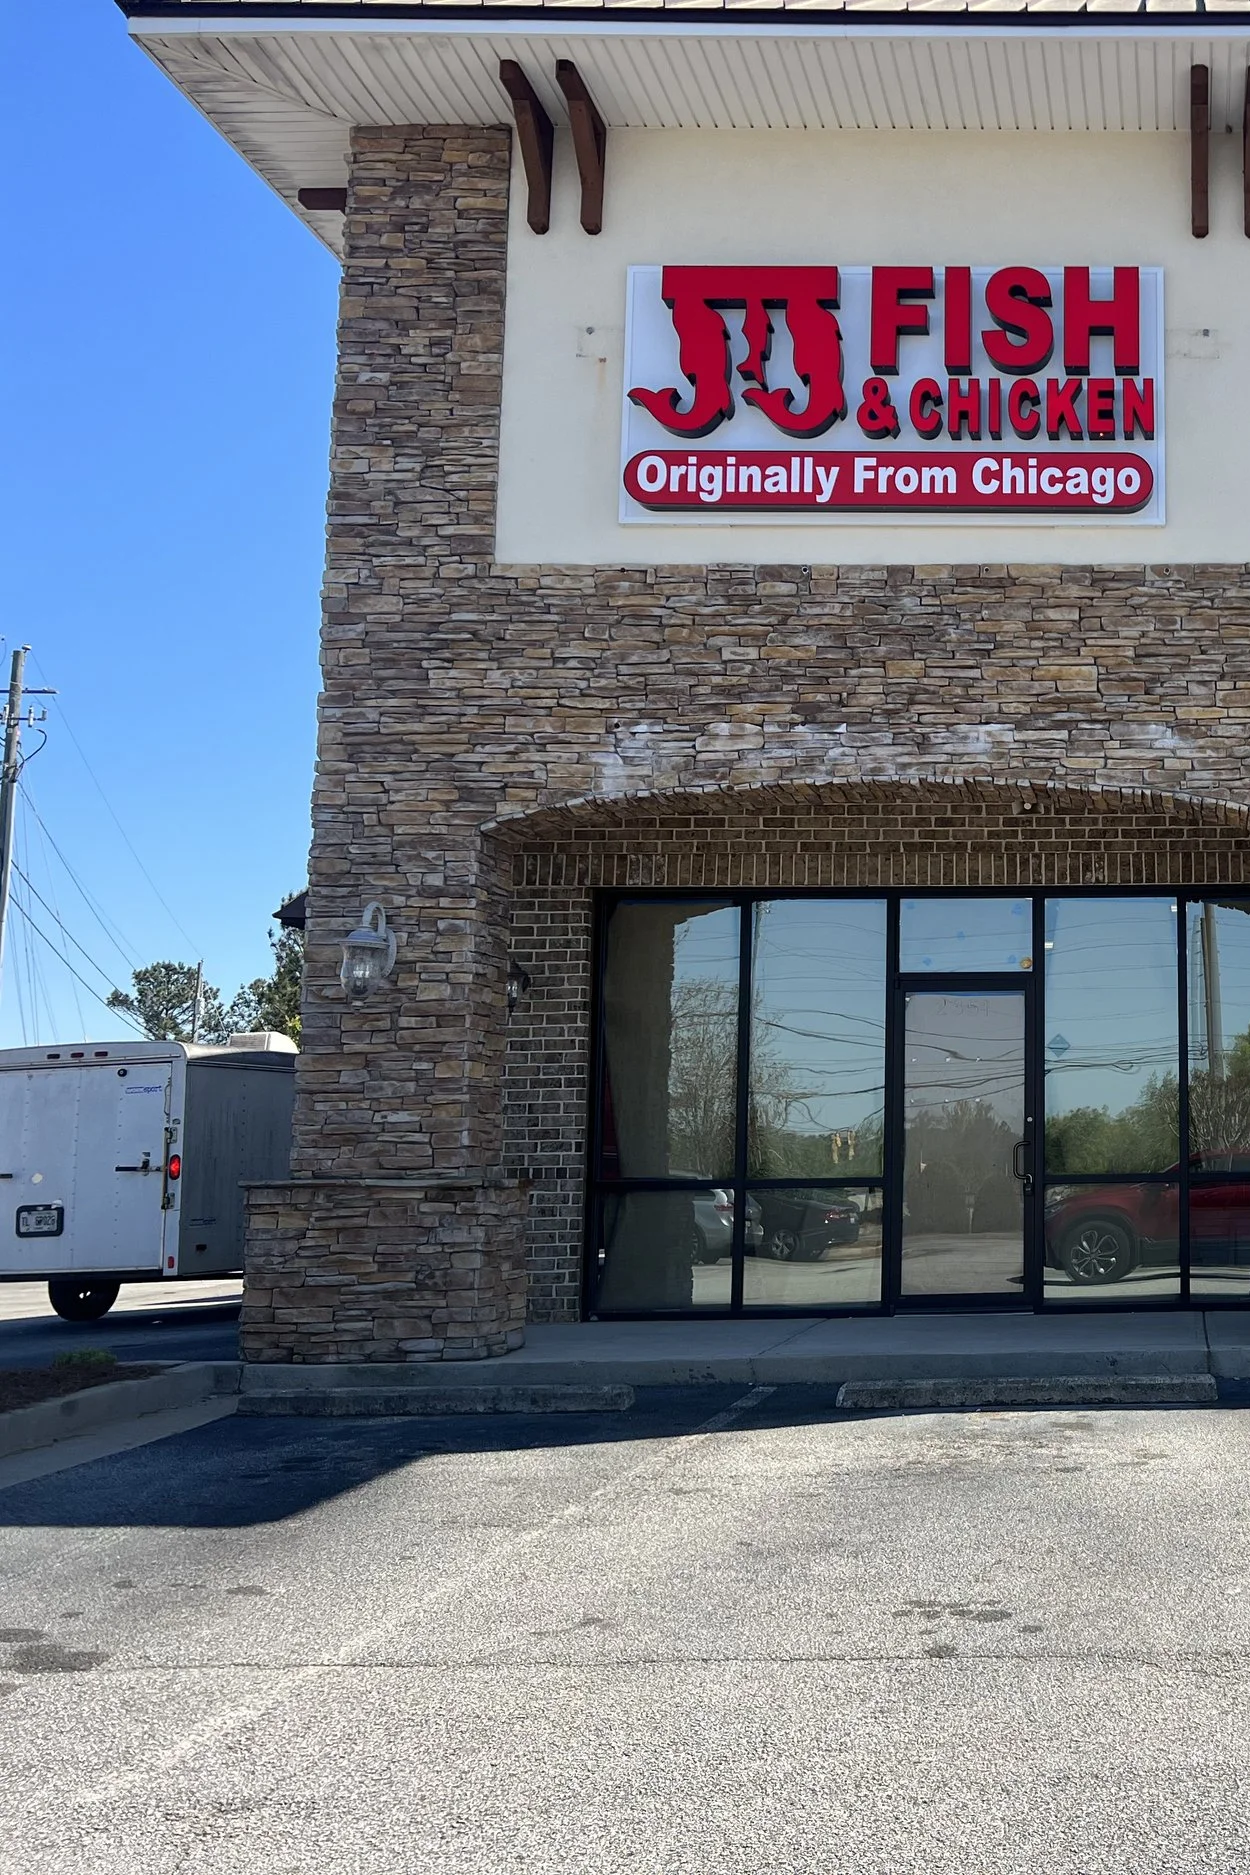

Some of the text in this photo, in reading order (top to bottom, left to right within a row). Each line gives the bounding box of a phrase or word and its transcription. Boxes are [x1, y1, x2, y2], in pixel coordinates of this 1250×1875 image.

[870, 266, 1140, 375] FISH
[857, 377, 1154, 441] & CHICKEN
[636, 455, 1141, 504] Originally From Chicago
